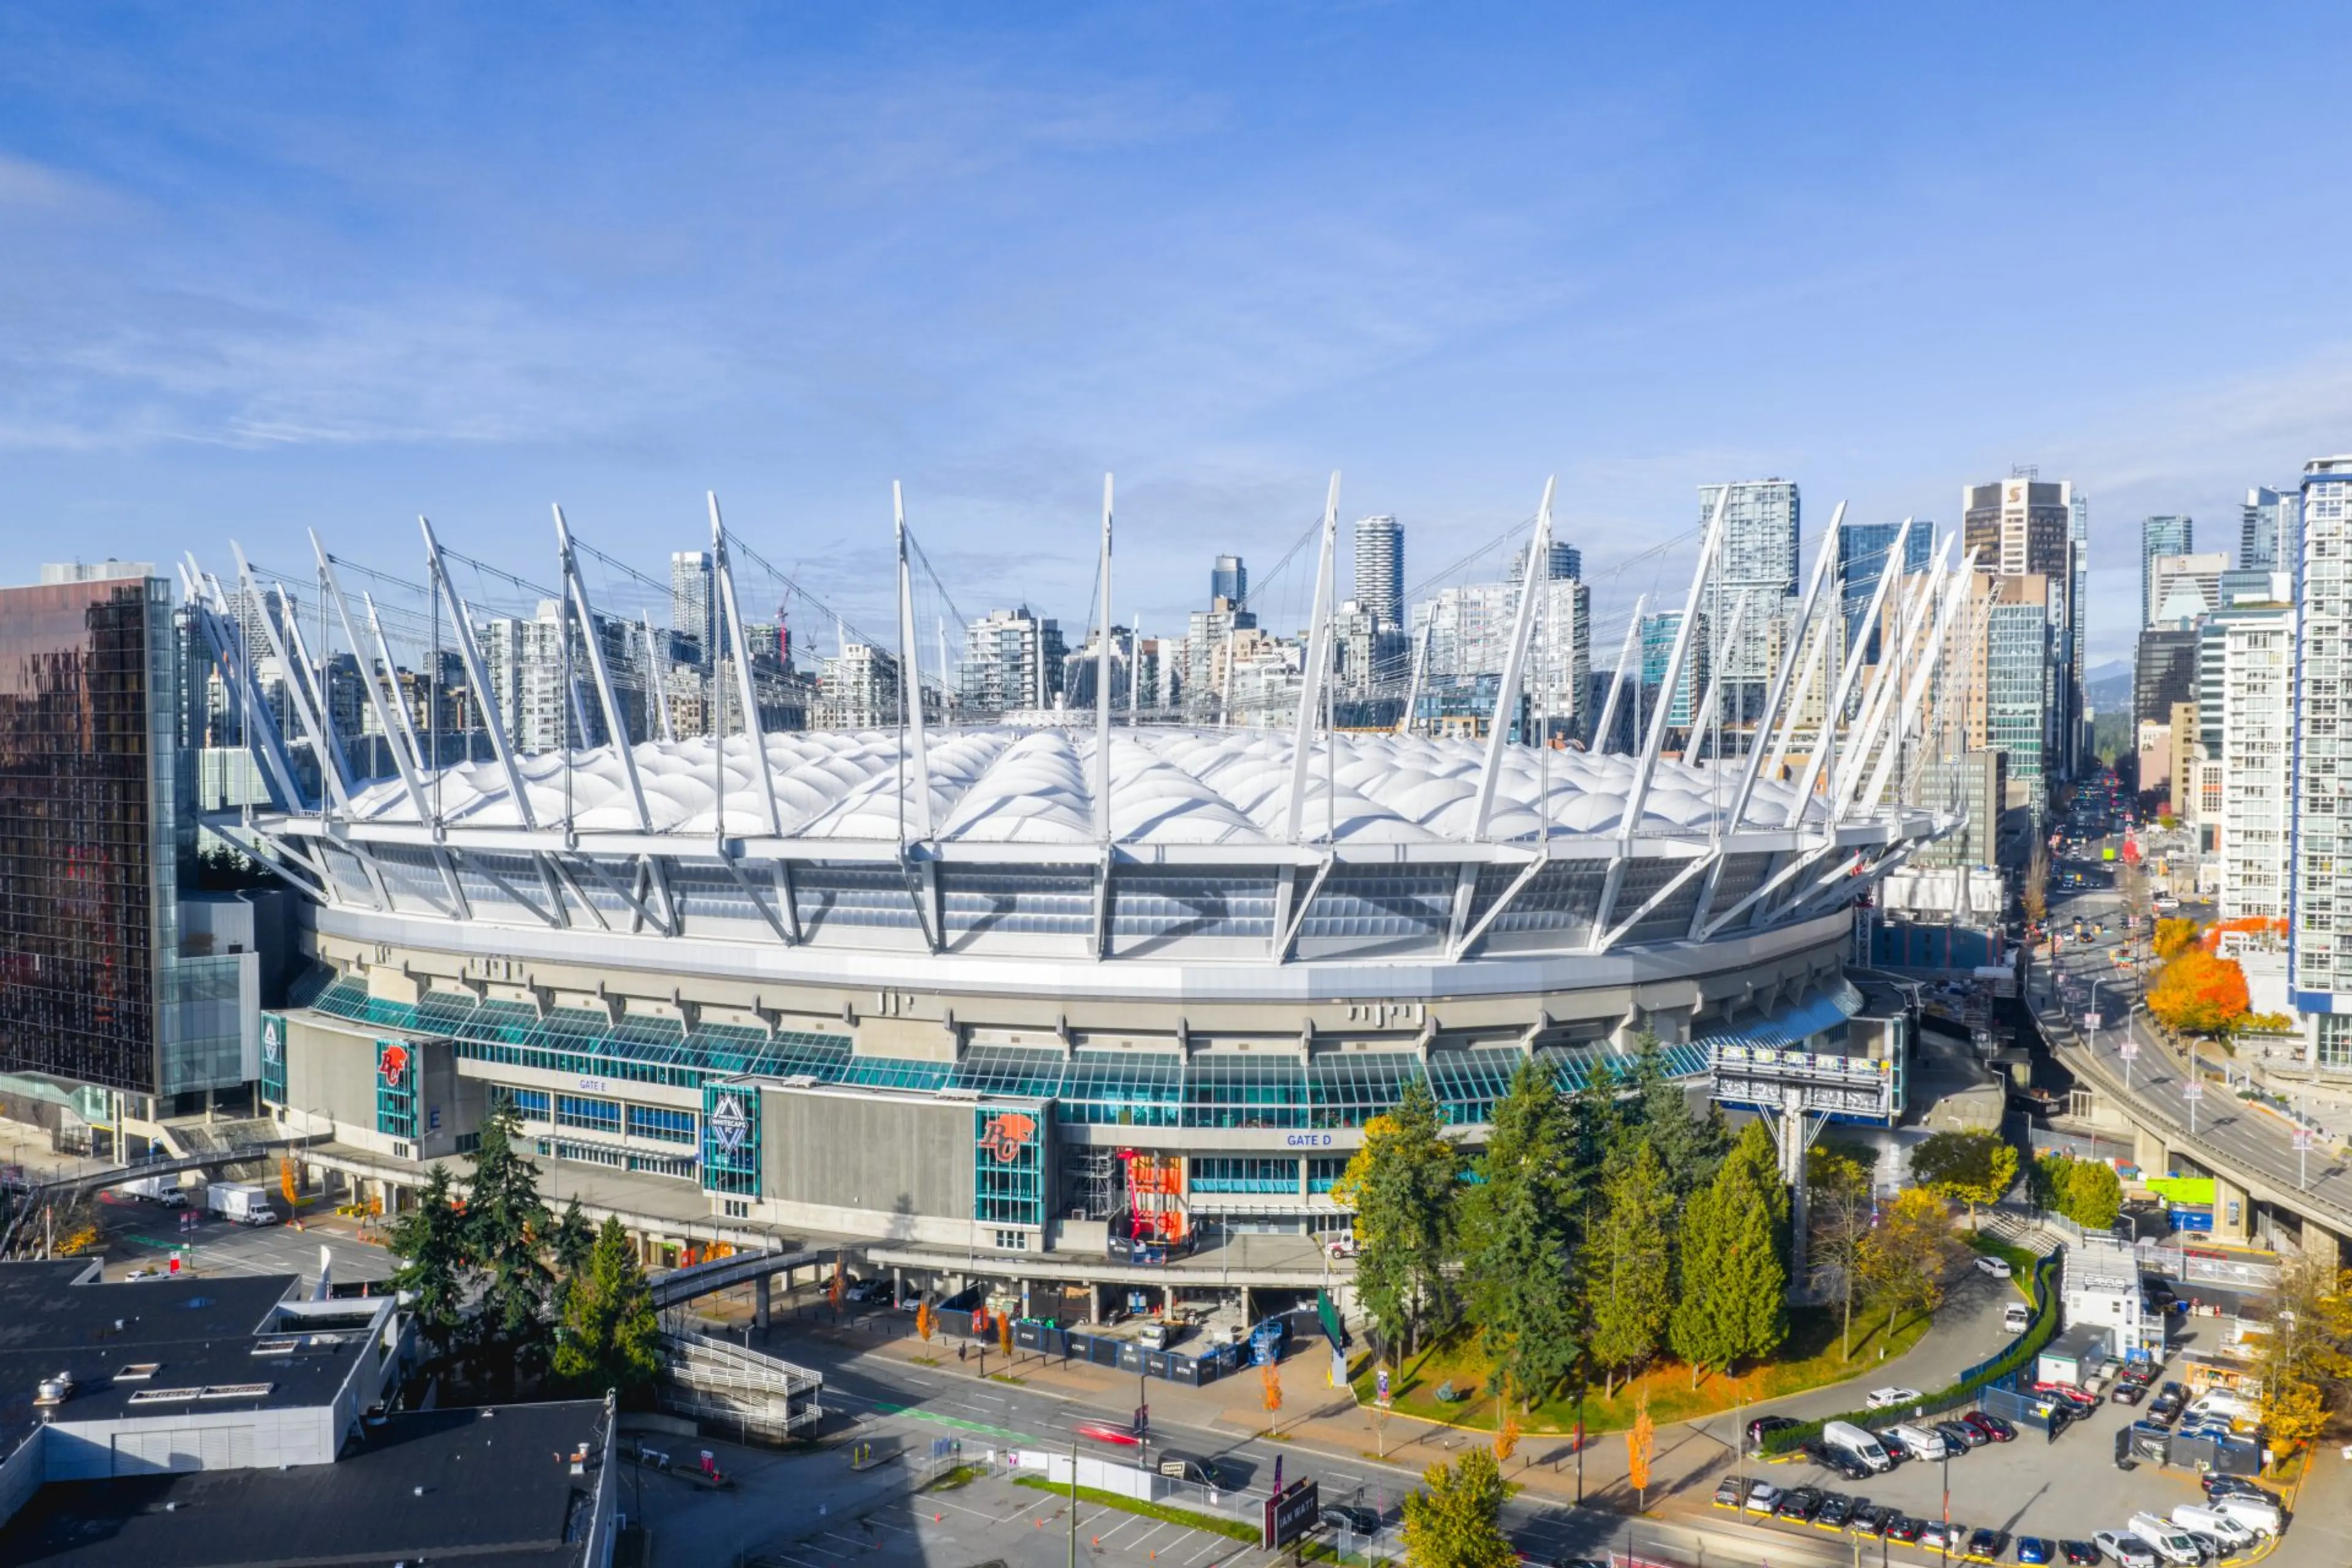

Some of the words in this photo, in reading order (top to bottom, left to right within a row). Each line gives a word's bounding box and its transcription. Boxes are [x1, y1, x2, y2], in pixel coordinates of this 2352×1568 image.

[579, 1079, 598, 1090] GATE
[601, 1082, 606, 1091] E
[430, 1107, 442, 1129] E
[712, 1119, 746, 1128] WHITECAPS
[1287, 1134, 1319, 1145] GATE
[1323, 1134, 1332, 1145] D
[1279, 1512, 1292, 1529] IAN
[1294, 1497, 1314, 1517] WATT
